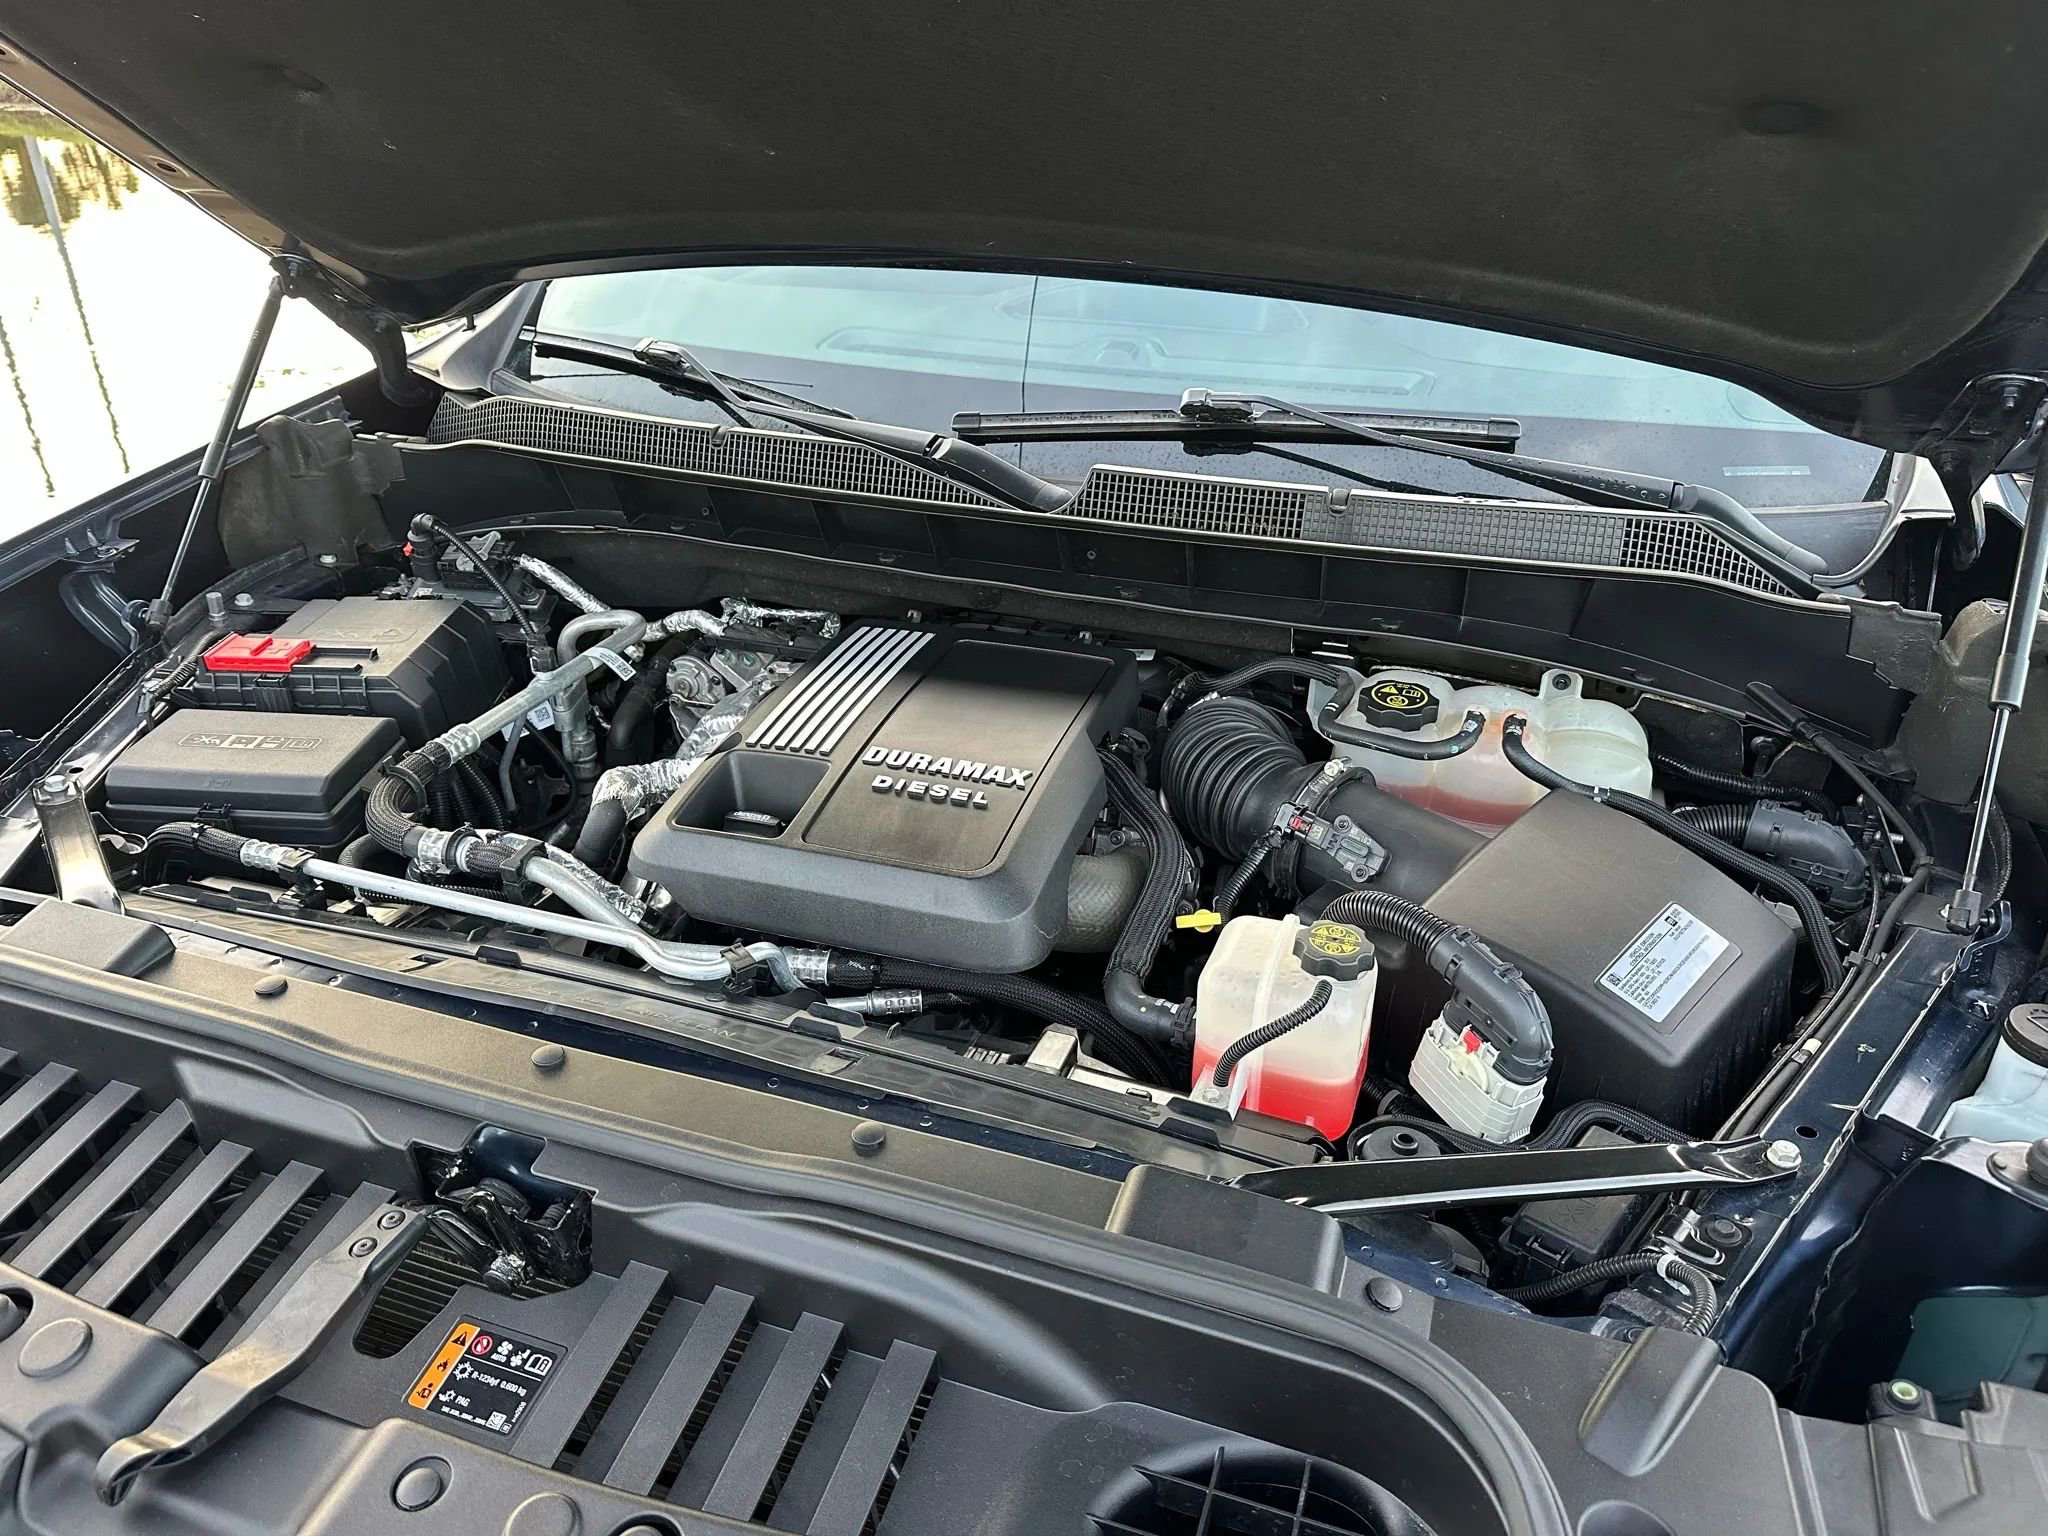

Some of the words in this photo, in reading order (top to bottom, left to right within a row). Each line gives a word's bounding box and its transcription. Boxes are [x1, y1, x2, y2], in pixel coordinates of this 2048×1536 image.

[862, 746, 1033, 790] DURAMAX
[872, 775, 989, 810] DIESEL
[455, 1395, 471, 1407] PAG
